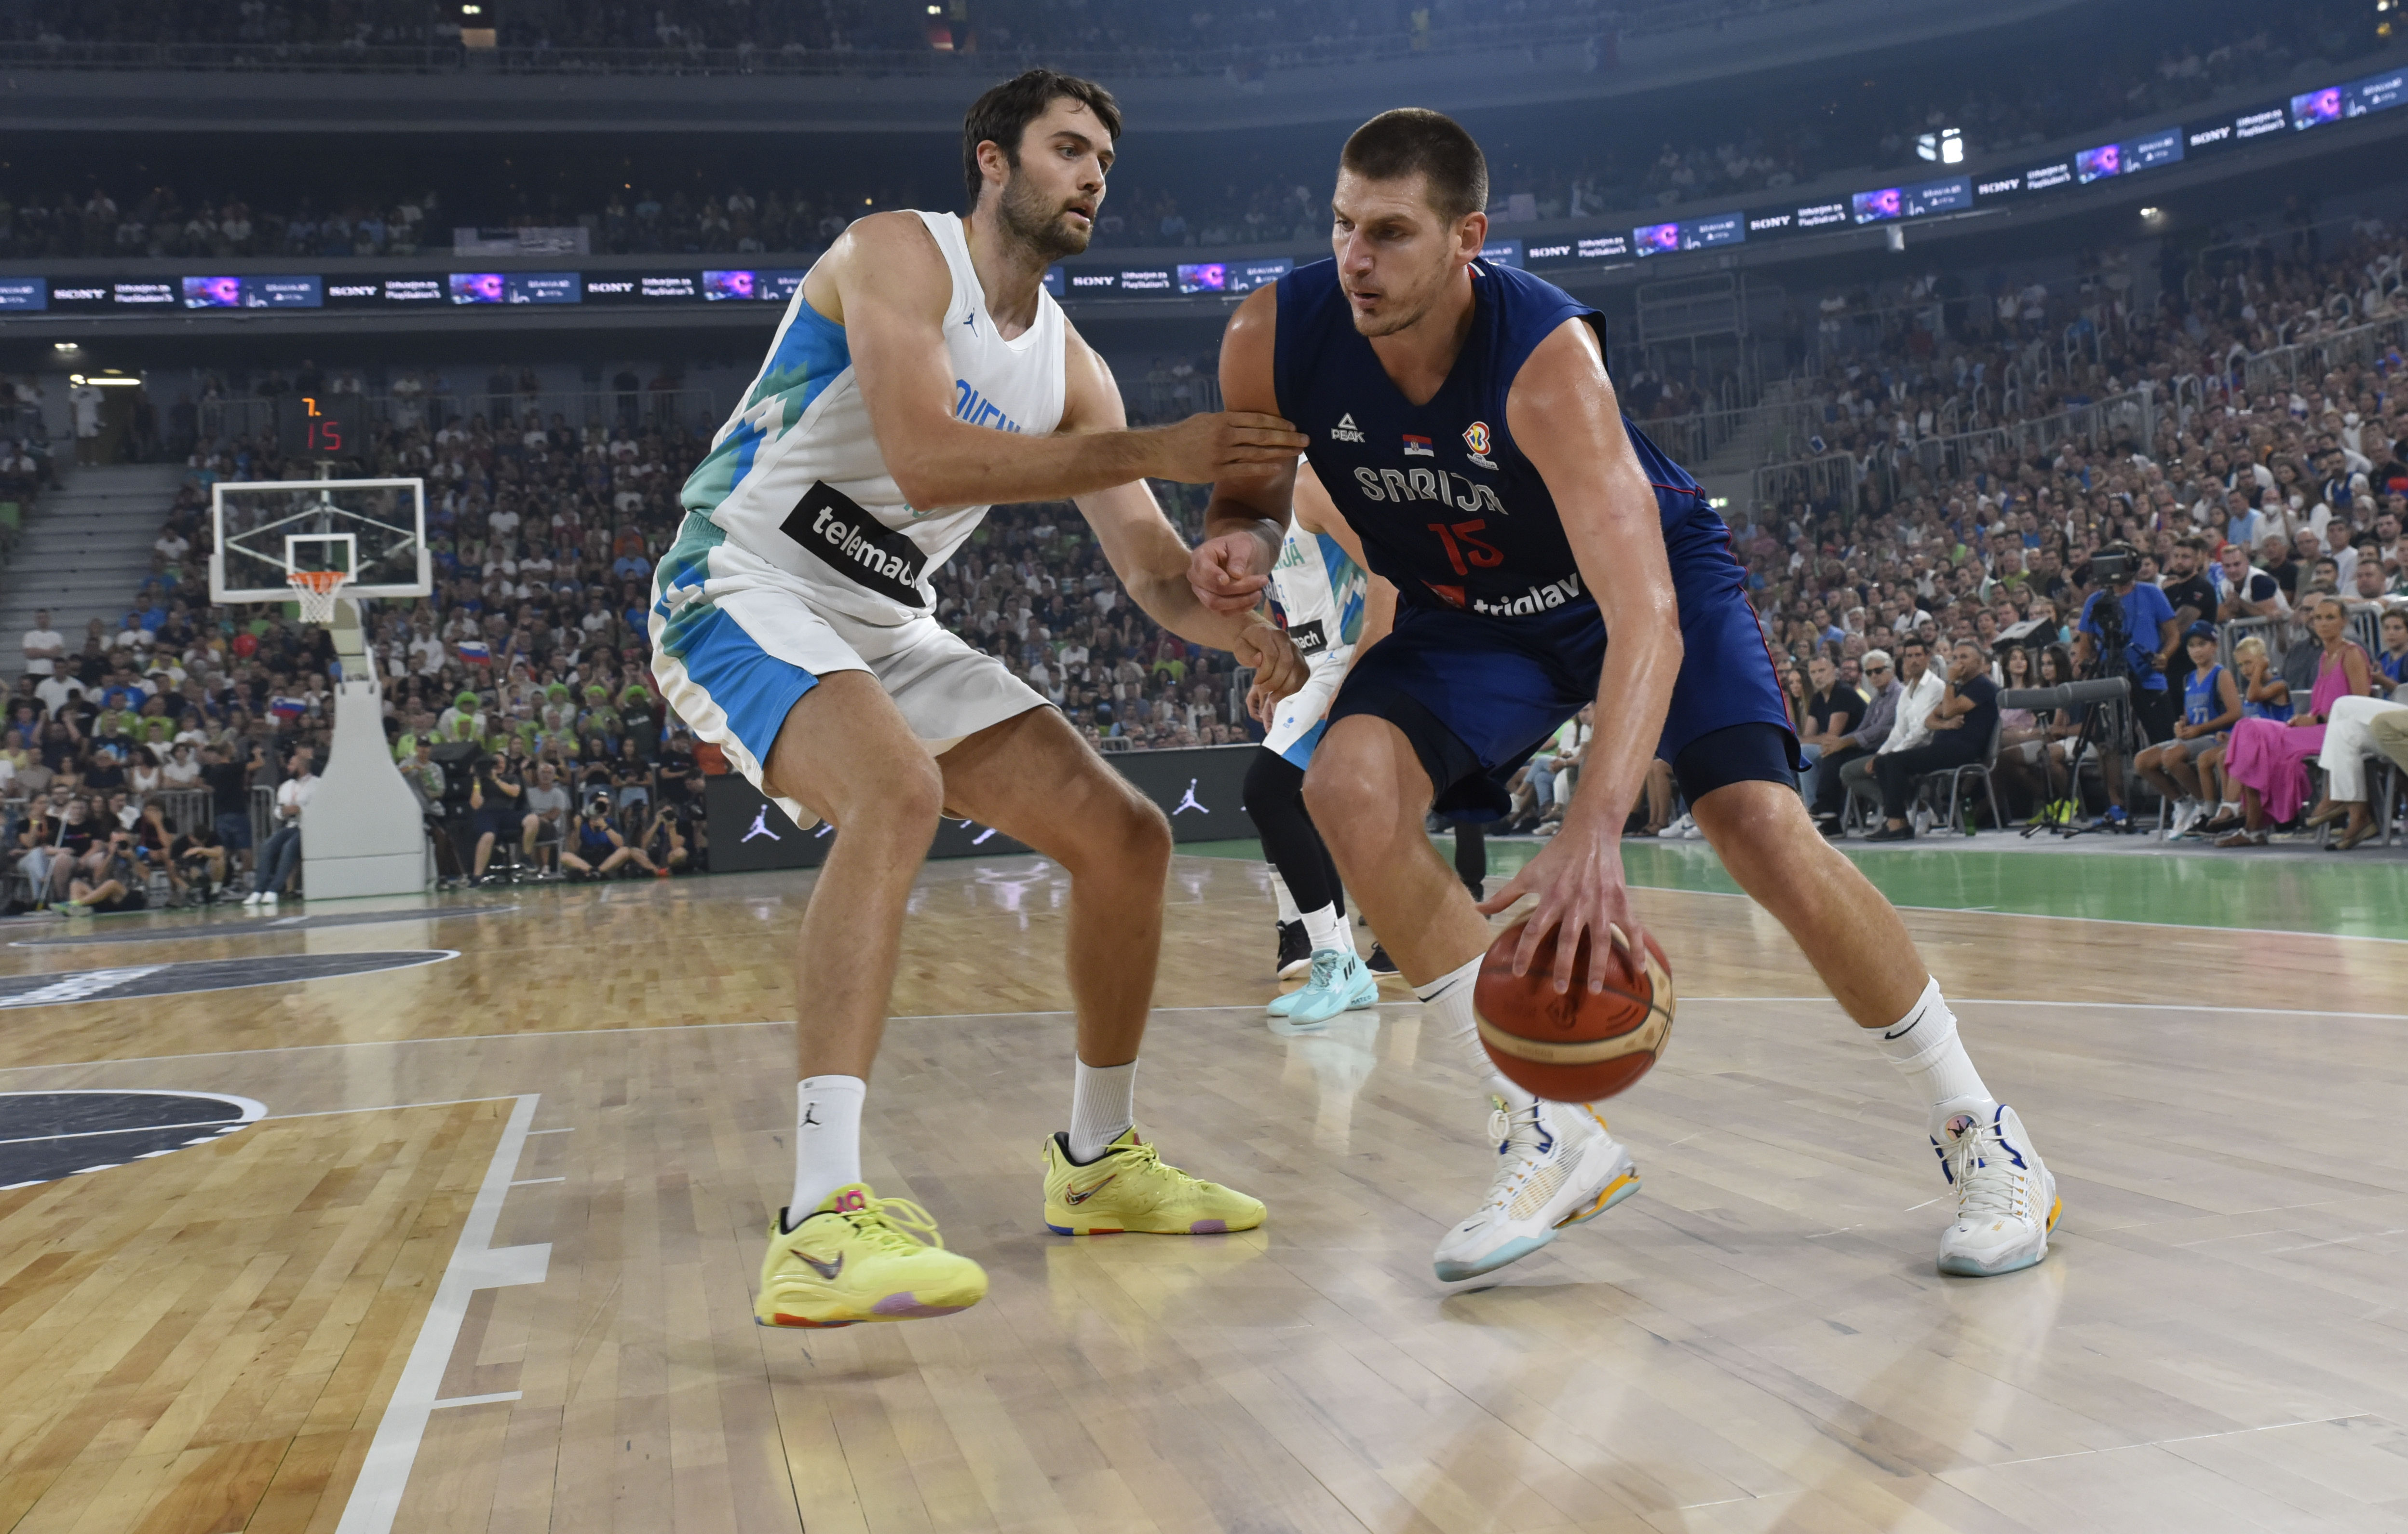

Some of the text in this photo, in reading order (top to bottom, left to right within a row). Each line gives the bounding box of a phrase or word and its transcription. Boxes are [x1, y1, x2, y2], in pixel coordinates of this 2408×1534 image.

[2190, 126, 2230, 146] SONY
[1978, 178, 2019, 194] SONY
[1751, 215, 1790, 230] SONY
[1529, 246, 1570, 258] SONY
[588, 283, 634, 293] SONY
[1073, 276, 1114, 285] SONY
[54, 289, 106, 299] SONY
[329, 286, 377, 296] SONY
[308, 421, 341, 450] 15
[1331, 428, 1366, 443] PEAK
[1354, 467, 1509, 515] SRBIJA
[1427, 519, 1504, 576] 15
